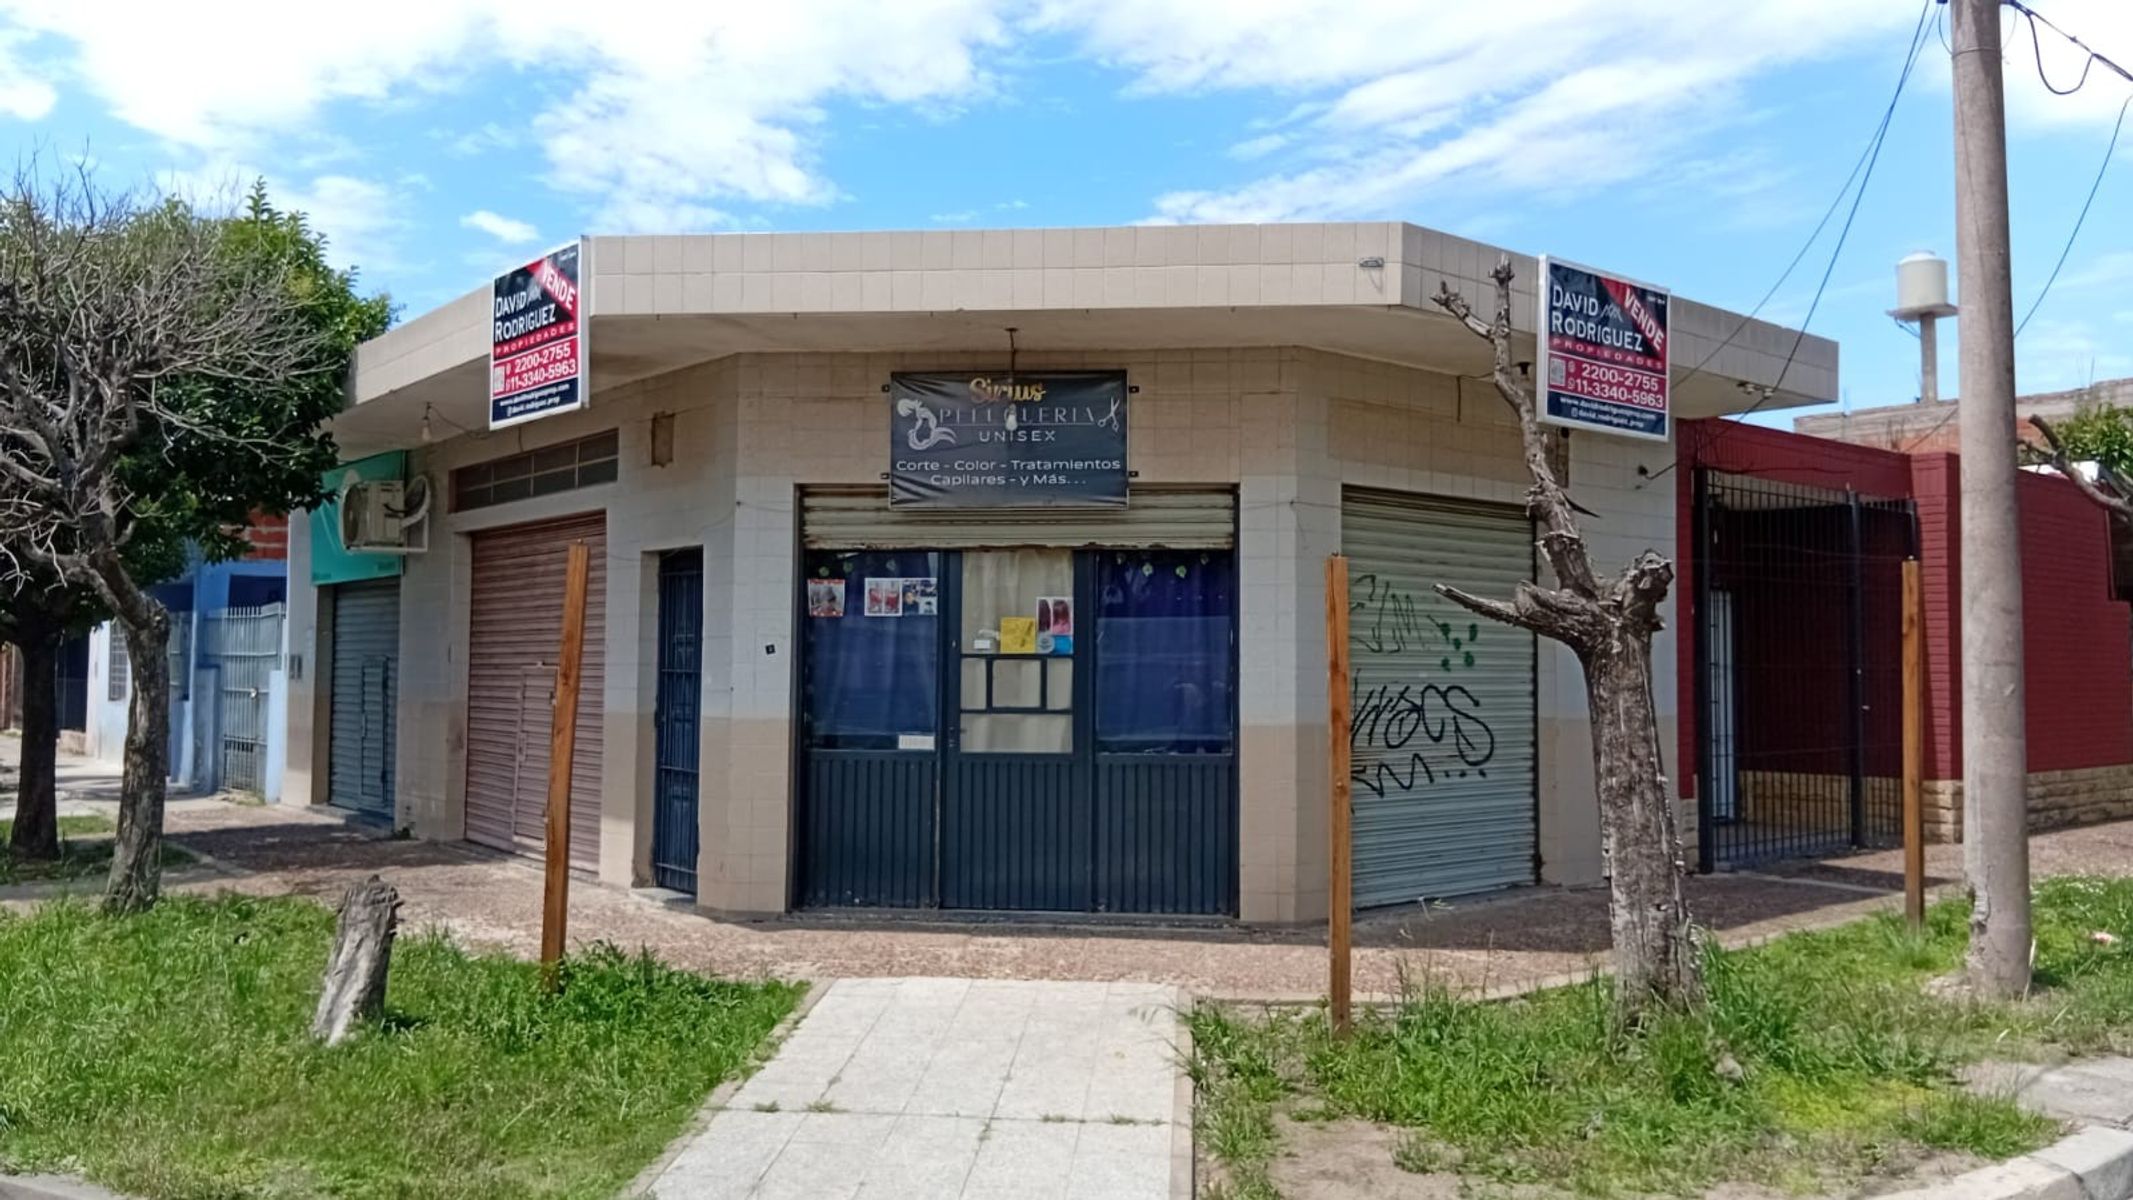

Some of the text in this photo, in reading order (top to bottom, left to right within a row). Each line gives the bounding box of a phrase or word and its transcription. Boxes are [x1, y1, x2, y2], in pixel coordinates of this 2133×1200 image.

[541, 262, 576, 311] VENDE
[1552, 285, 1598, 316] DAVID
[495, 291, 527, 318] DAVID
[1623, 287, 1665, 351] VENDE
[495, 304, 556, 342] RODRIGUEZ
[1552, 312, 1643, 352] RODRIGUEZ
[495, 323, 576, 356] PROPIEDADES
[1553, 338, 1662, 369] PROPIEDADES
[514, 342, 571, 374] 2200-2755
[509, 359, 576, 389] 11-3340-5963
[1581, 363, 1659, 392] 2200-2755
[969, 377, 1046, 404] Sirius
[1576, 379, 1664, 408] 11-3340-5963
[979, 430, 1056, 442] UNISEX
[896, 460, 940, 471] Corte
[954, 460, 997, 471] Color
[1010, 459, 1121, 471] Tratamientos
[930, 474, 1006, 487] Capilares
[1019, 476, 1029, 486] y
